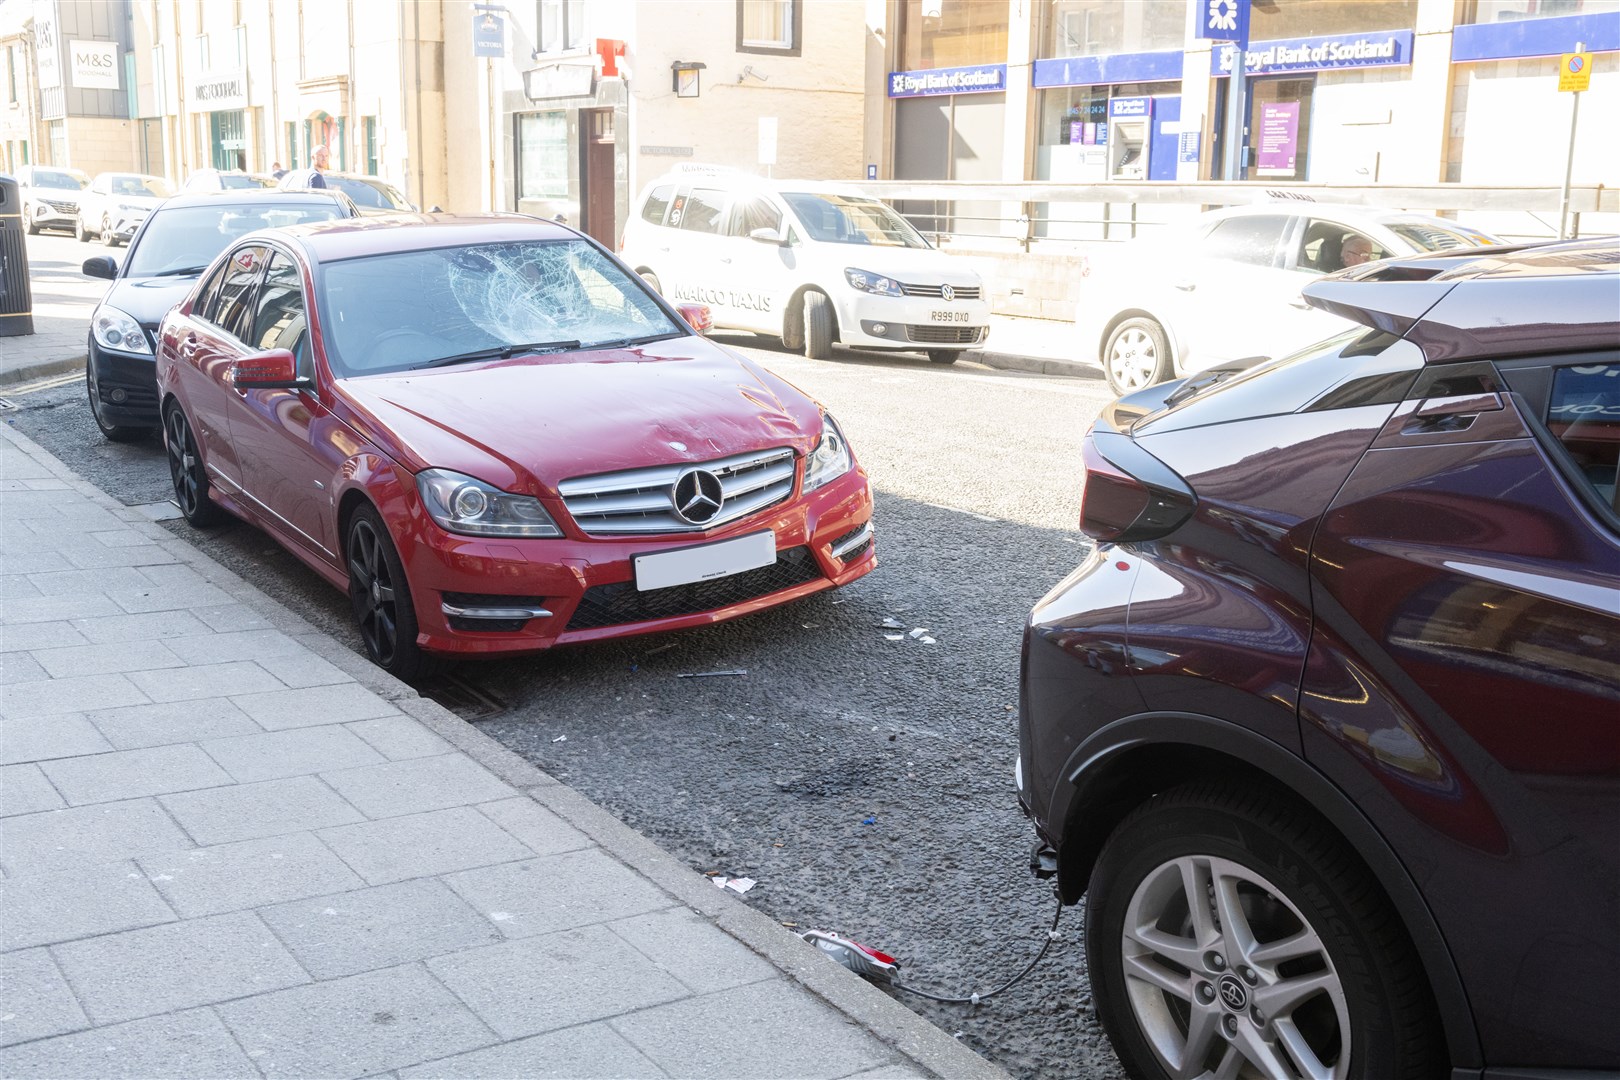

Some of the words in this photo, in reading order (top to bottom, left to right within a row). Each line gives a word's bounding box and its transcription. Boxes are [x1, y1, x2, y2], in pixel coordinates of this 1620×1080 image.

[477, 41, 503, 49] VICTORIA
[76, 52, 113, 68] M&S
[1245, 46, 1275, 70] oyal
[1277, 43, 1311, 64] Bank
[1311, 41, 1329, 62] of
[1329, 37, 1396, 61] Scotland
[78, 70, 113, 78] FOODHALL
[904, 74, 927, 92] Royal
[928, 73, 949, 88] Bank
[949, 72, 959, 86] of
[959, 69, 999, 85] Scotland
[673, 281, 726, 306] MARCO
[728, 289, 772, 313] TAXIS
[931, 311, 953, 322] R999
